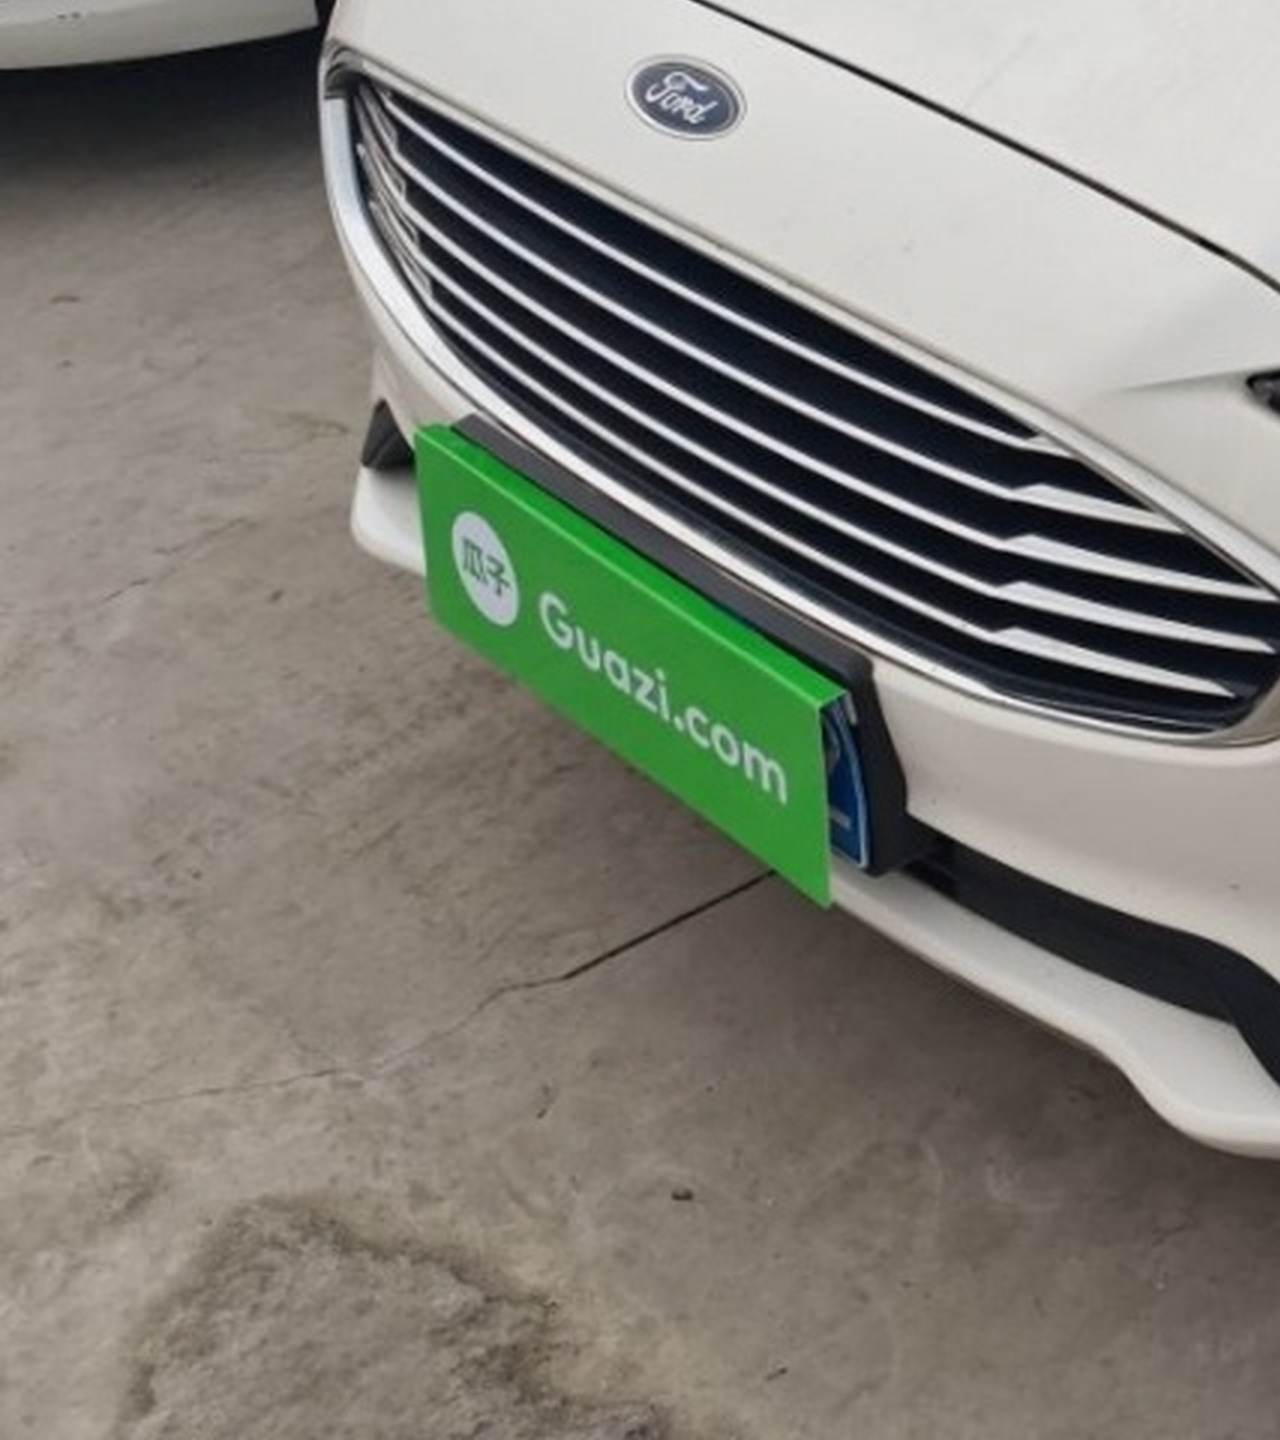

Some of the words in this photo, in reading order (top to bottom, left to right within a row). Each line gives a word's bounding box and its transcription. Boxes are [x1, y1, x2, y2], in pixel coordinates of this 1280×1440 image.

[645, 71, 718, 123] Ford
[462, 537, 511, 597] 瓜子
[538, 591, 788, 806] Guazi.com
